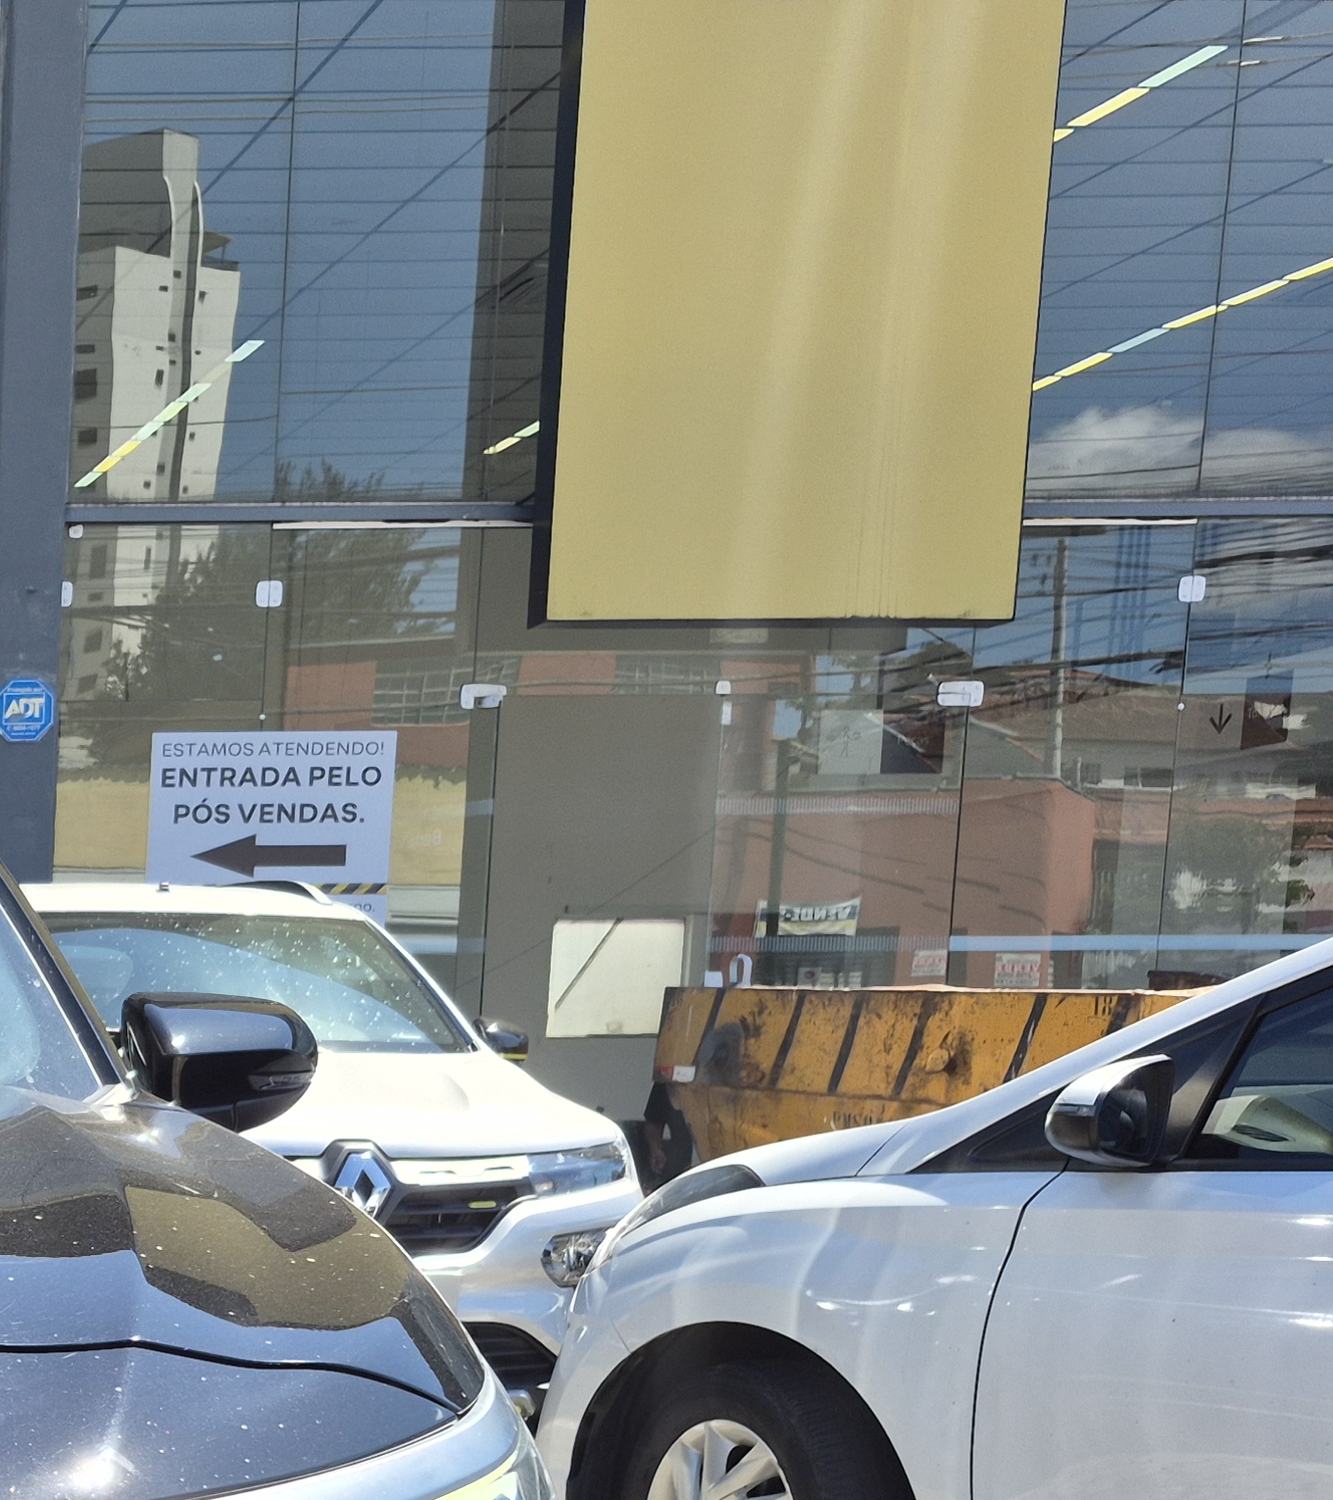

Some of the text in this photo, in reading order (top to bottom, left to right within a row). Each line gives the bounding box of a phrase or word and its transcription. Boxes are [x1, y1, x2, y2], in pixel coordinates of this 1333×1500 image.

[4, 697, 44, 719] ADT
[162, 741, 384, 757] ESTAMOS ATENDENDO!
[160, 766, 382, 788] ENTRADA PELO
[173, 798, 365, 825] PÓS VENDAS.
